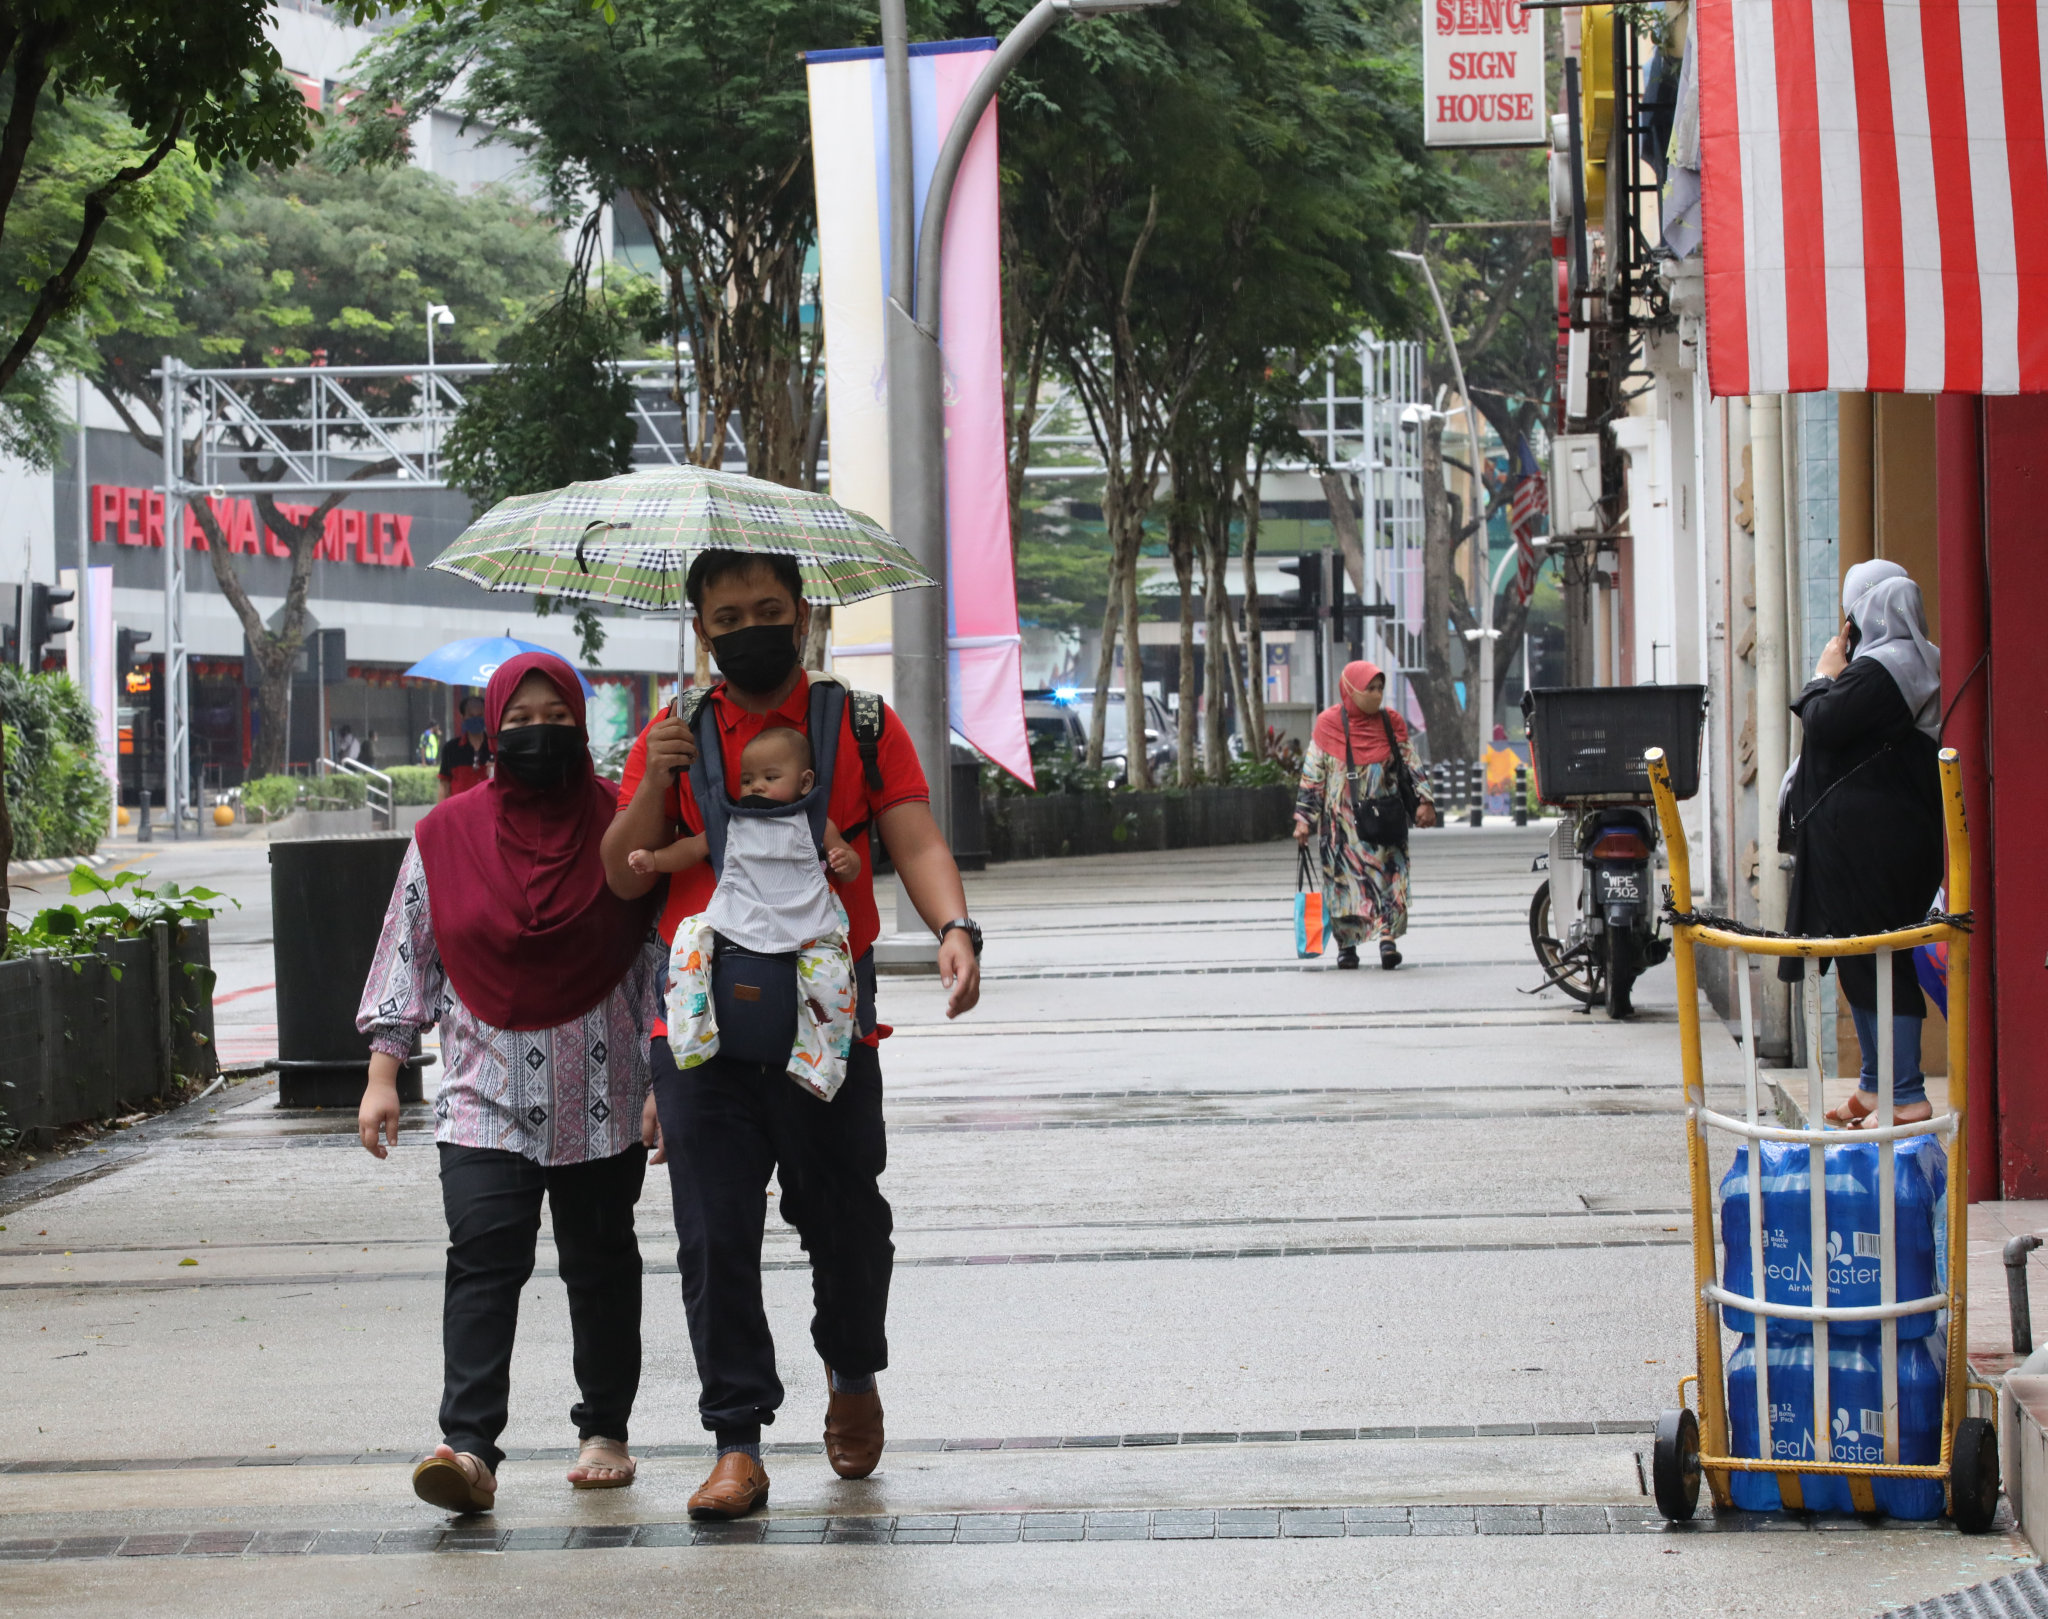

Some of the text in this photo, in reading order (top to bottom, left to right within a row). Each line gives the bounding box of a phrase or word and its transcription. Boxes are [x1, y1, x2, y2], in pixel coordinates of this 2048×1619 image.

[1449, 51, 1517, 80] SIGN
[1436, 93, 1534, 123] HOUSE
[92, 484, 261, 556] PERAMA
[1609, 876, 1635, 887] WPE
[1604, 887, 1639, 898] 7302
[1774, 1229, 1785, 1237] 12
[1788, 1284, 1801, 1292] Air
[1781, 1403, 1792, 1411] 12
[1780, 1416, 1794, 1424] Pack
